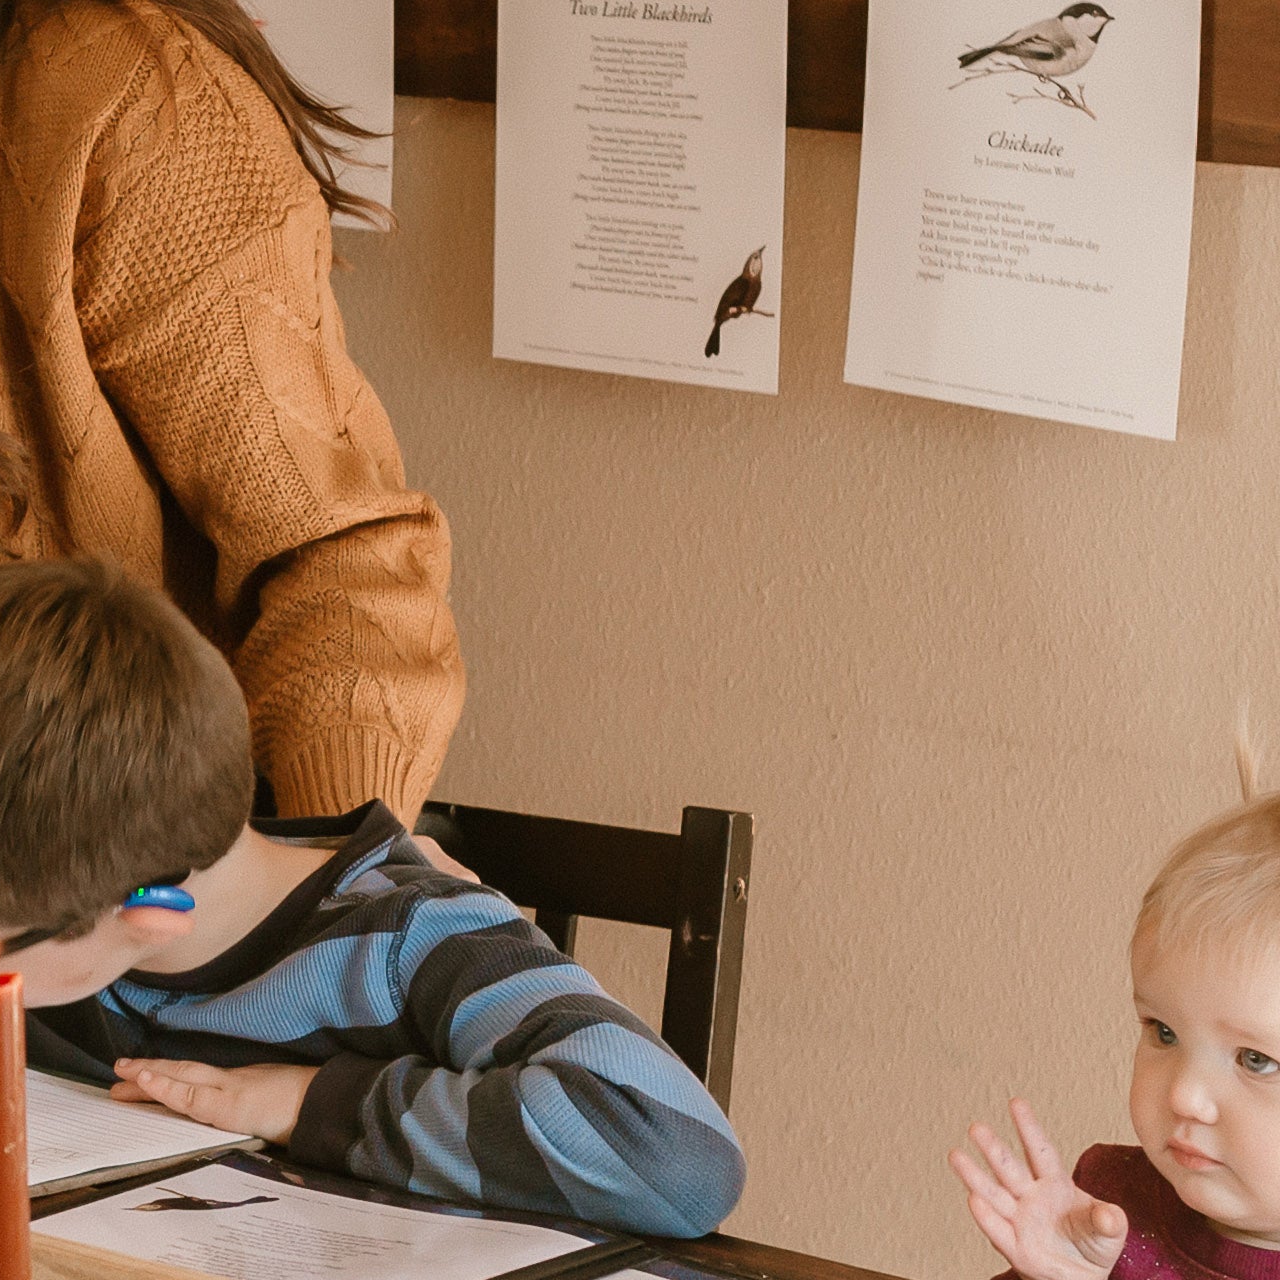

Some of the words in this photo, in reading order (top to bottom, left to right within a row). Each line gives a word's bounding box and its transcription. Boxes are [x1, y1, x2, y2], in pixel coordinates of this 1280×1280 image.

[602, 0, 638, 19] Little
[641, 2, 713, 24] Blackbirds
[987, 130, 1064, 157] Chickadee
[985, 211, 1000, 221] and
